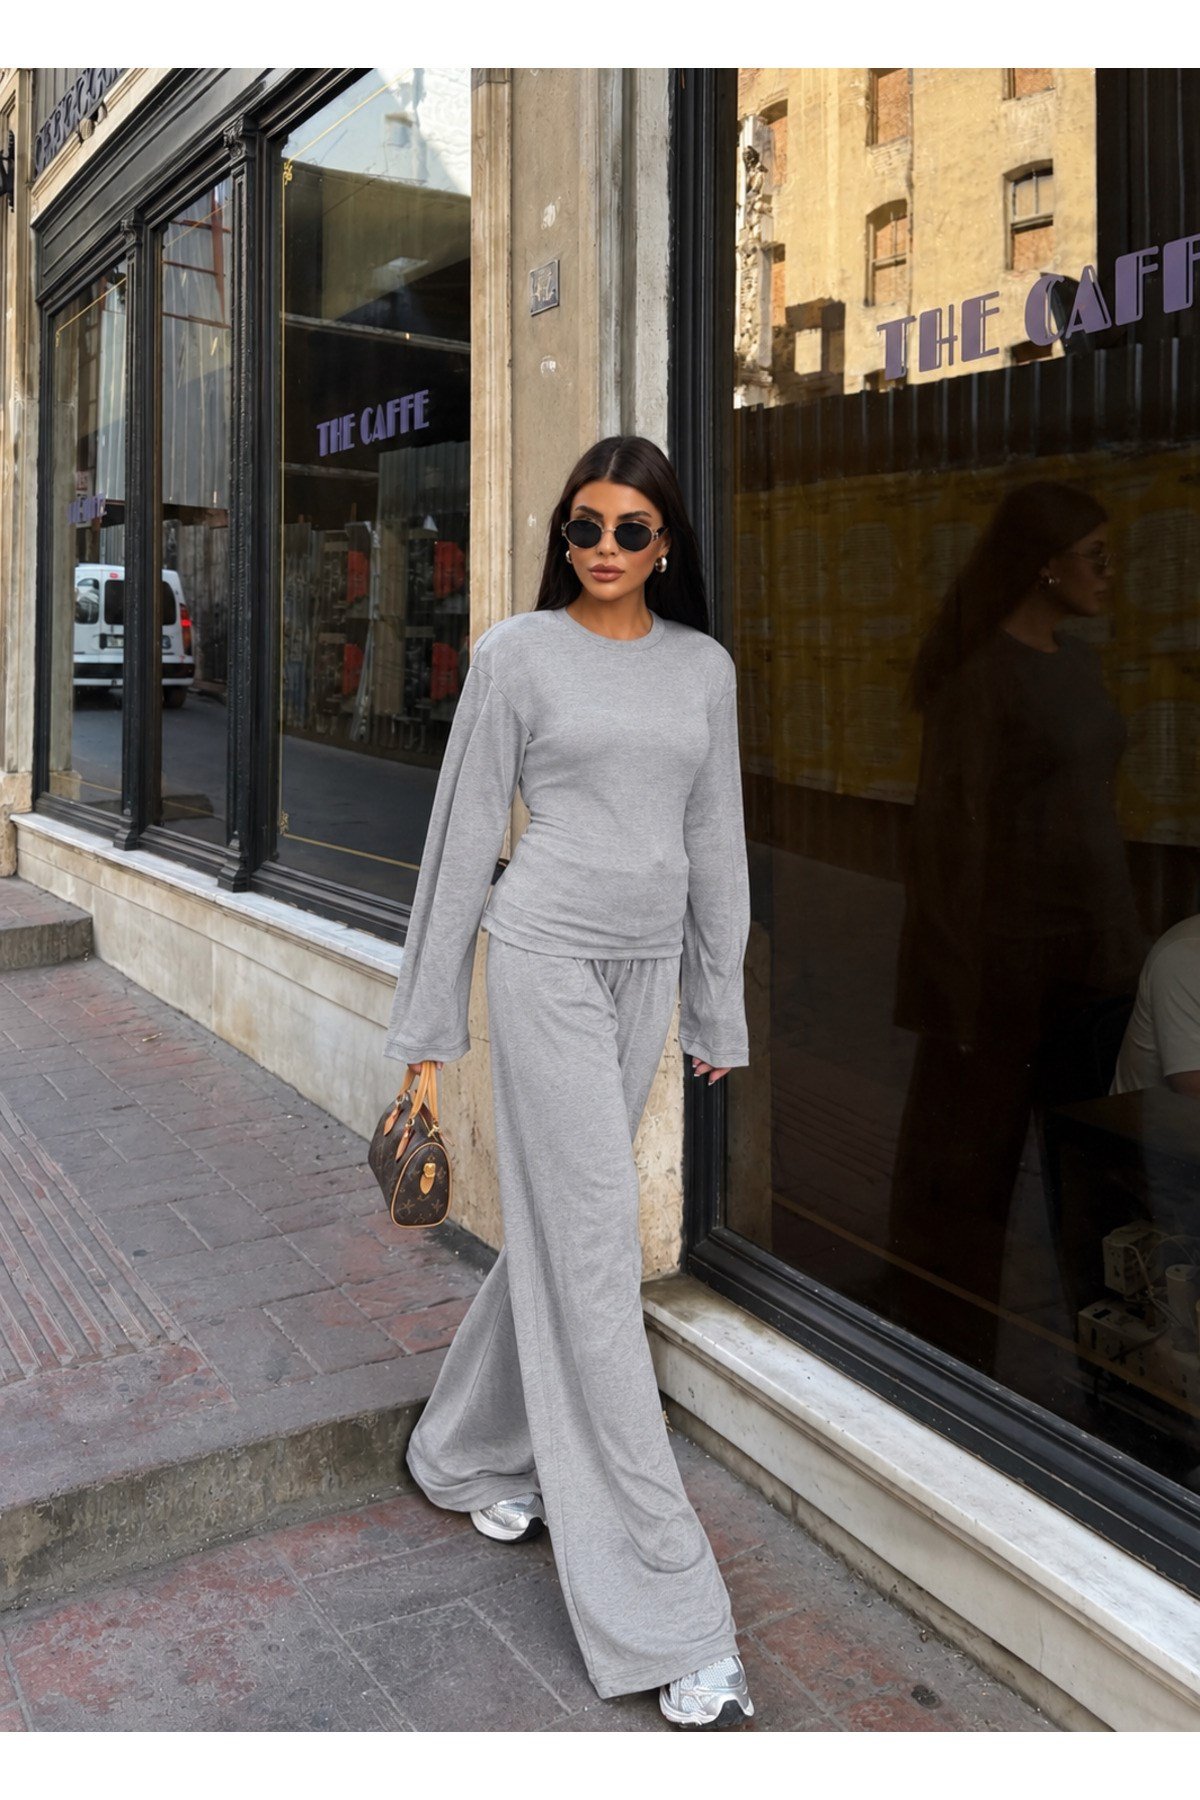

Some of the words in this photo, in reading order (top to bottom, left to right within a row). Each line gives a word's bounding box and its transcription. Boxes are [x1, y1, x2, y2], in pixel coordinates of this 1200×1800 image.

[876, 290, 1000, 381] THE
[316, 412, 356, 457] THE
[360, 389, 430, 446] CAFFE
